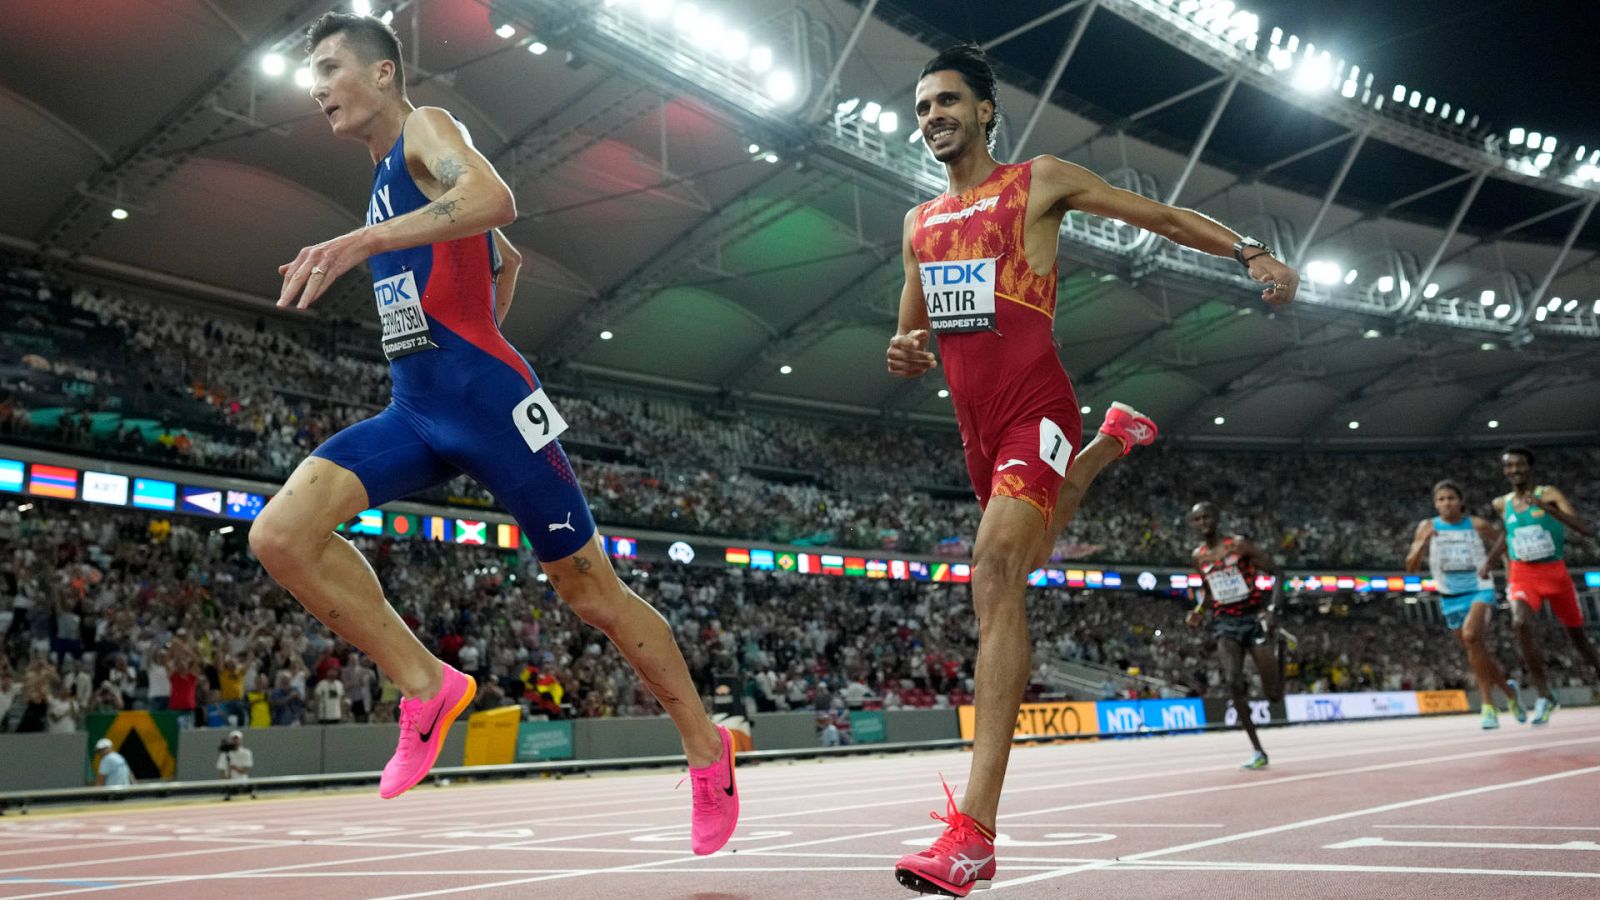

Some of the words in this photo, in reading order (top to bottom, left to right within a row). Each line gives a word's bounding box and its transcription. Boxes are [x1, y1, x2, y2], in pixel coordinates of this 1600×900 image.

[366, 184, 394, 227] AY
[925, 262, 986, 286] TDK
[375, 277, 411, 308] TDK
[932, 318, 976, 329] BUDAPEST
[976, 317, 989, 326] 23
[416, 336, 428, 346] 23
[526, 402, 550, 436] 9
[1050, 433, 1061, 462] 1
[1014, 706, 1081, 736] EIKO
[1162, 705, 1198, 729] NTN
